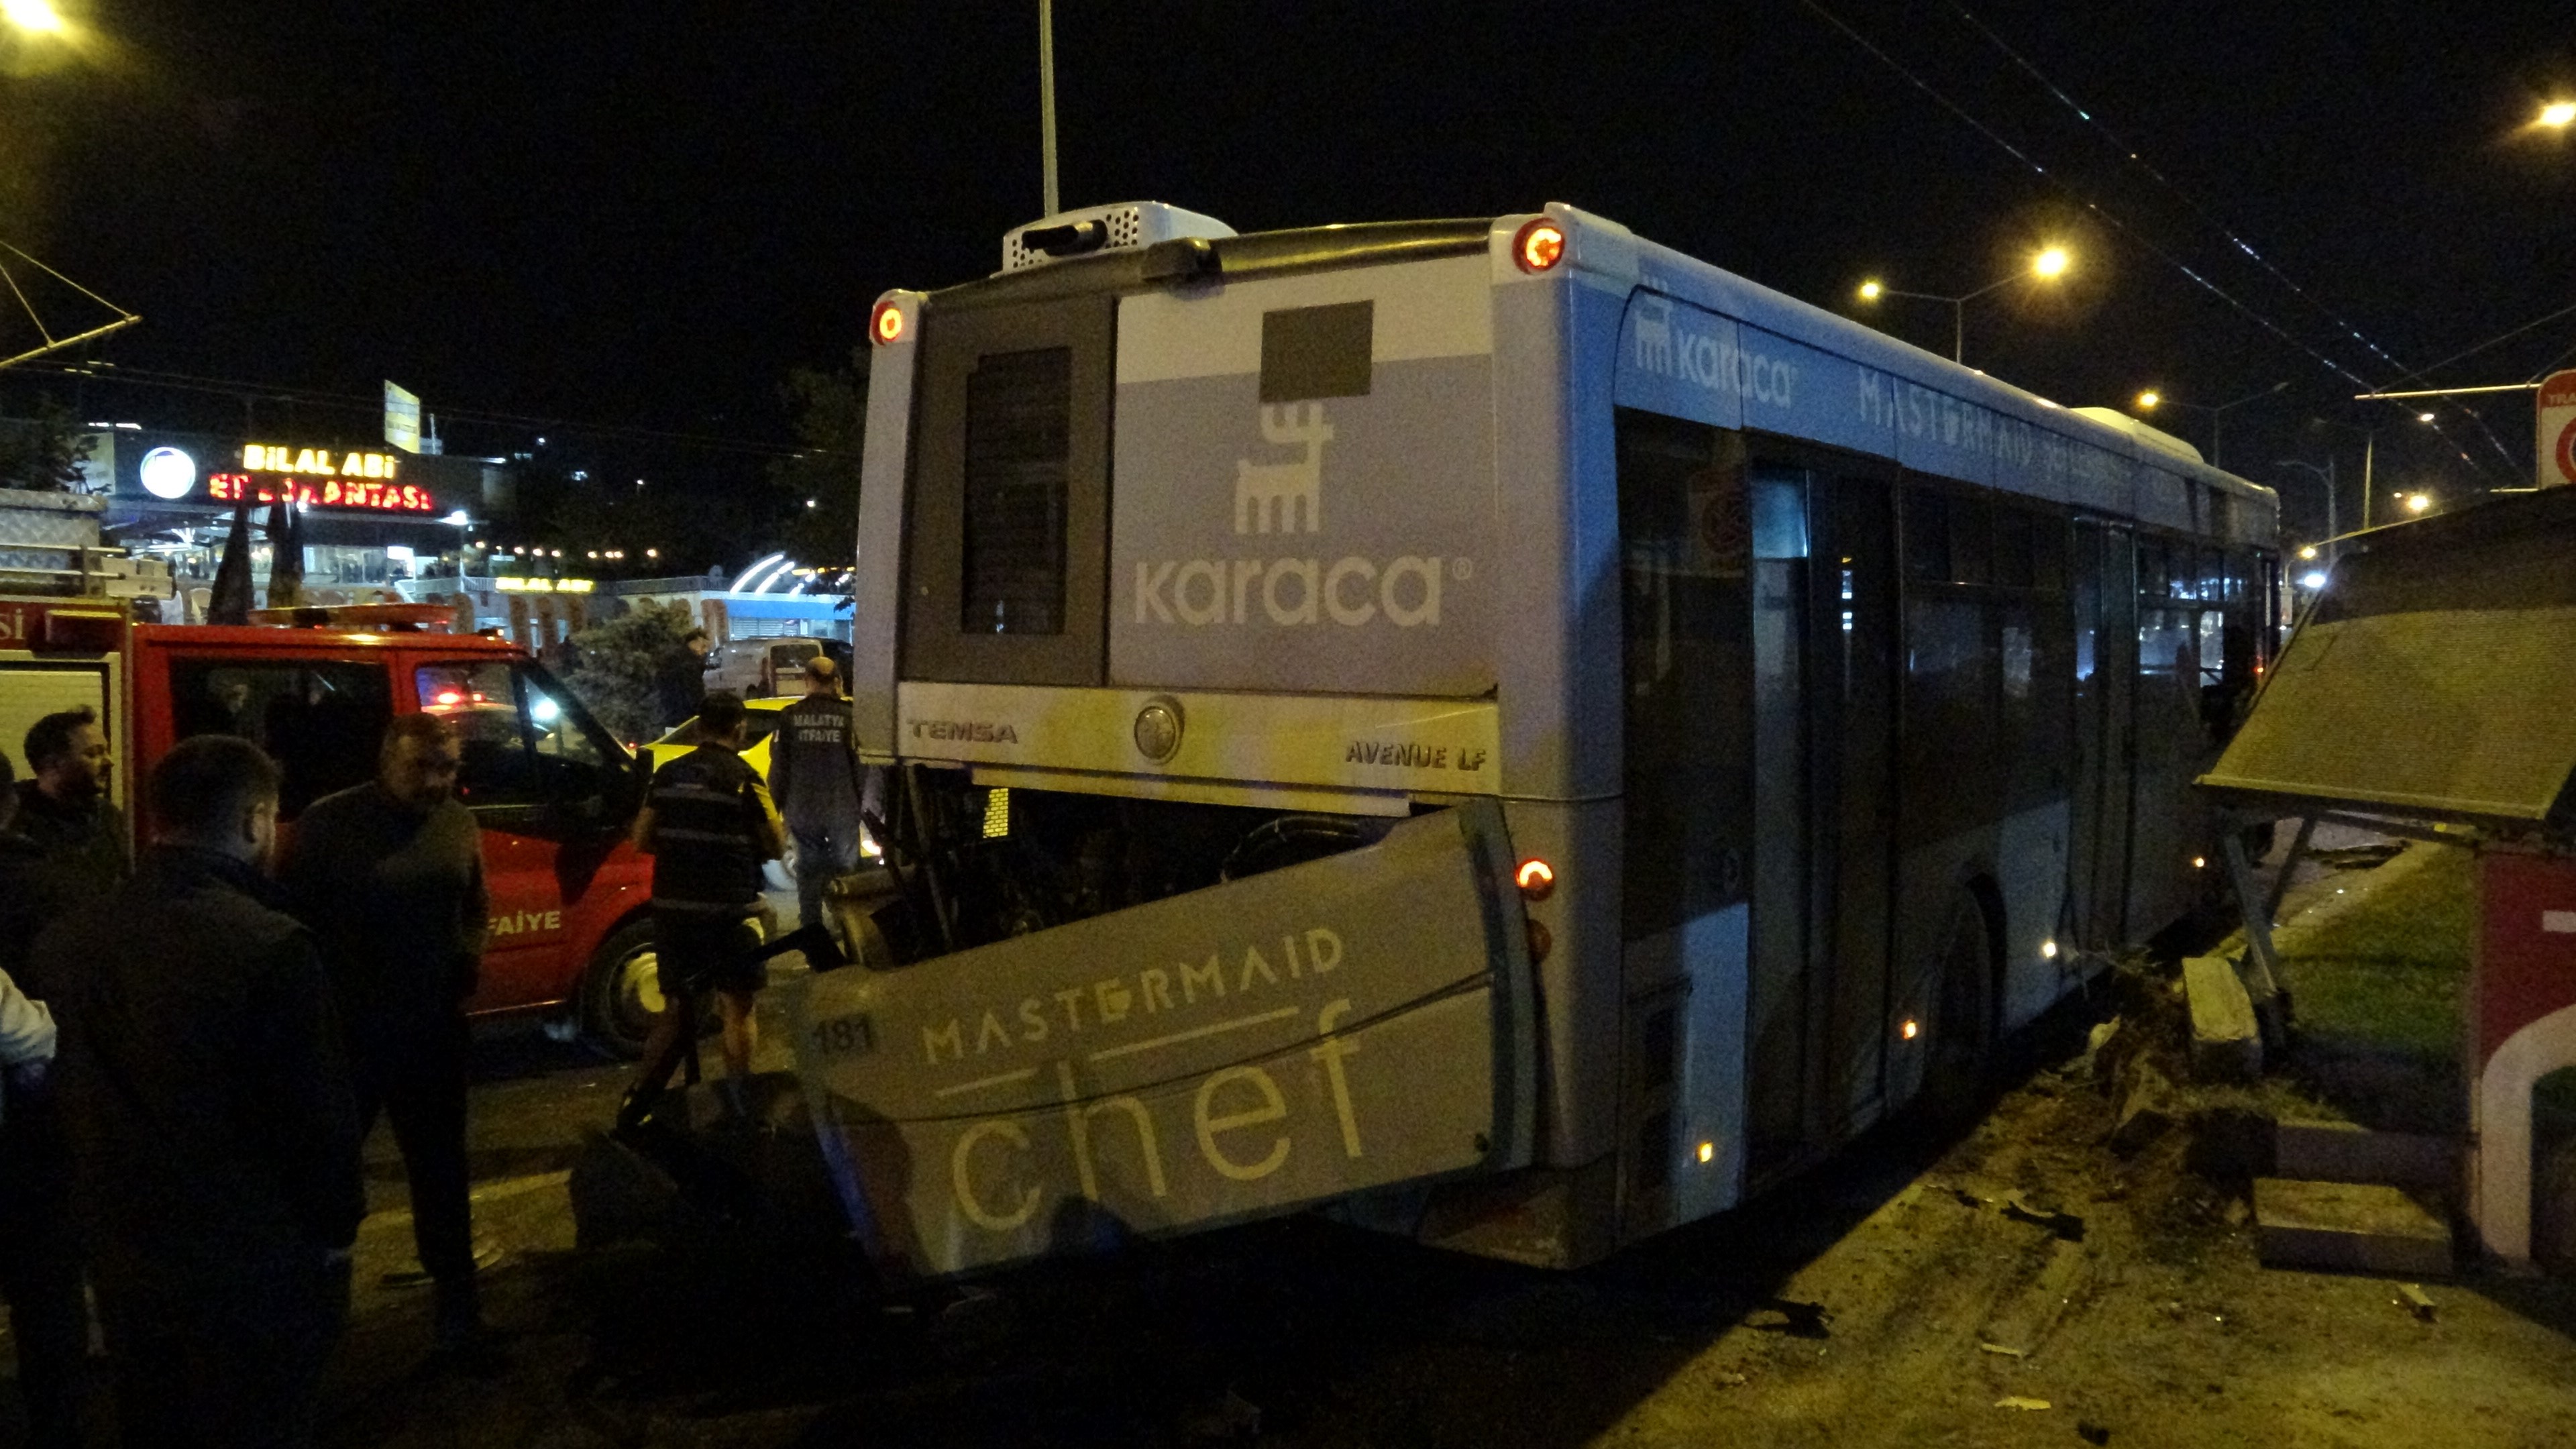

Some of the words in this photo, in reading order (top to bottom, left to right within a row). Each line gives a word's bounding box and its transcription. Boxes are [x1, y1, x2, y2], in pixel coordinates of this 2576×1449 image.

[906, 719, 1019, 745] TEMSA
[1345, 740, 1447, 769] AVENUE
[1457, 747, 1487, 771] LF
[921, 928, 1343, 1065] MASTERMAID
[812, 1012, 873, 1055] 181
[953, 998, 1362, 1231] chef
